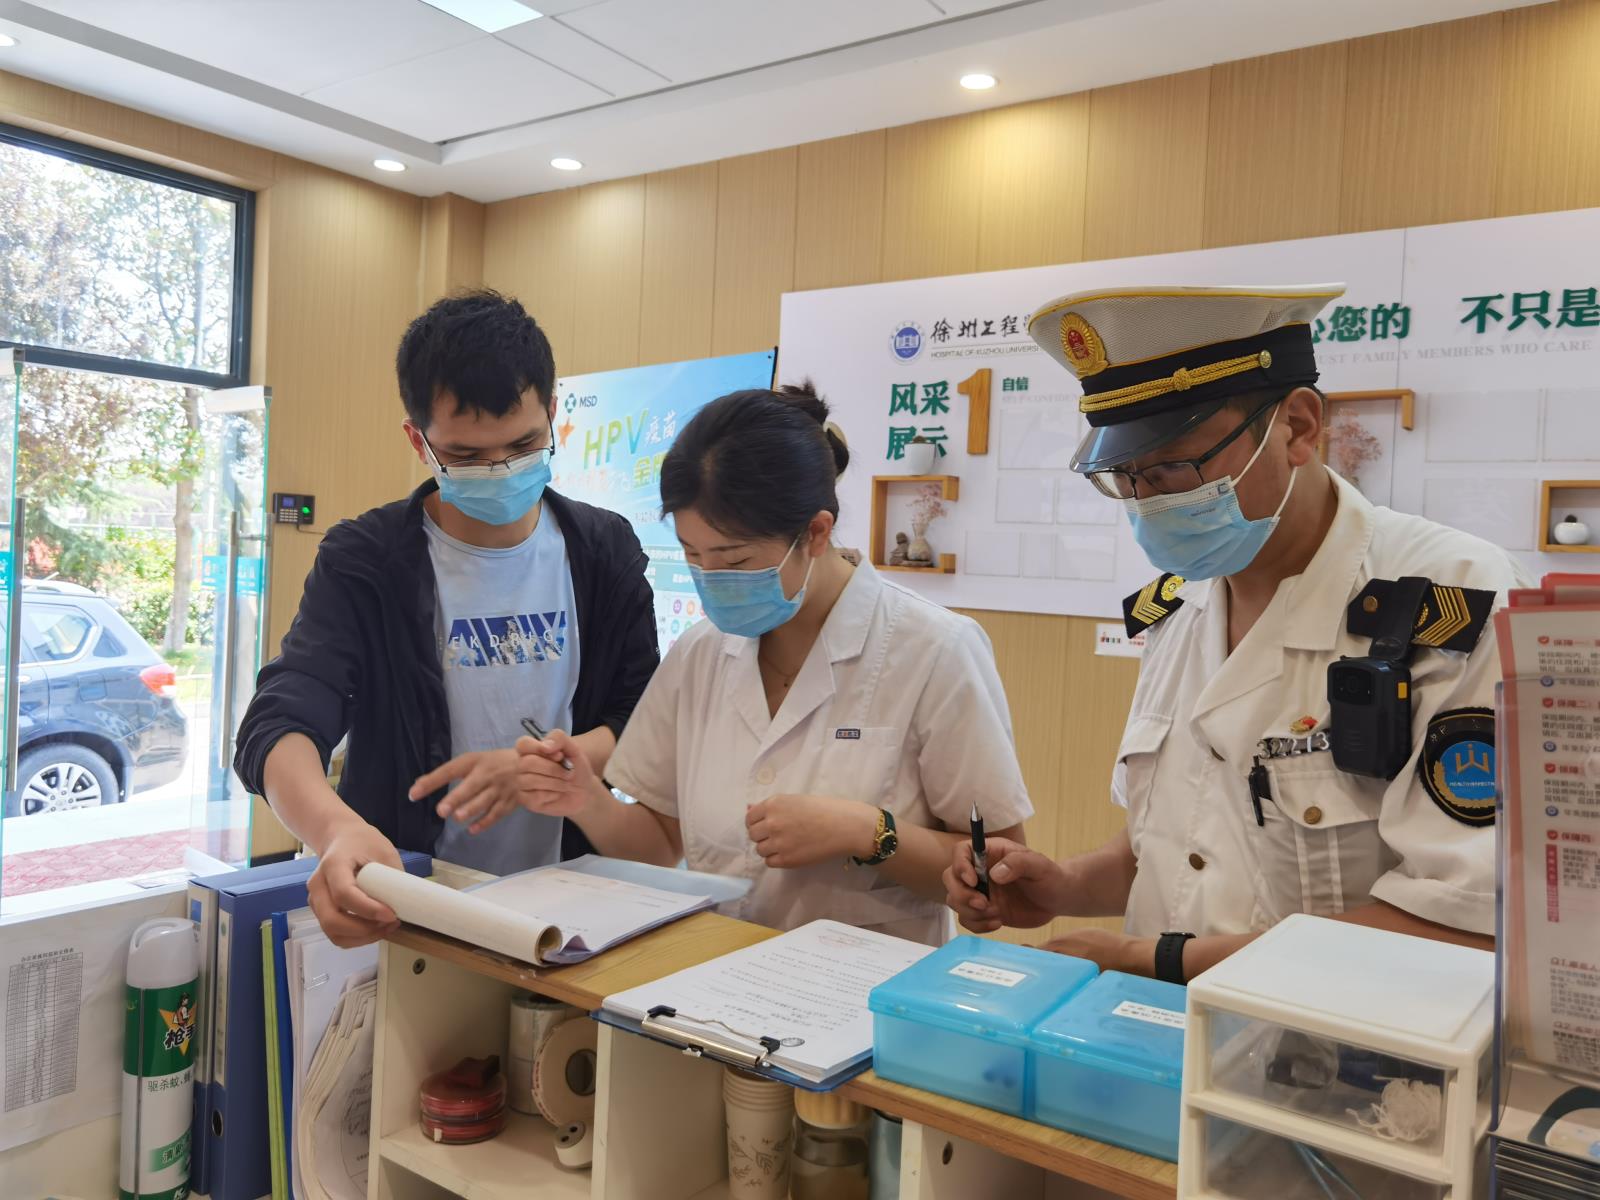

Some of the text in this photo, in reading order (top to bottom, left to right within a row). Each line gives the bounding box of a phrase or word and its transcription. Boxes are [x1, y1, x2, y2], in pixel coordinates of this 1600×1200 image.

[1460, 287, 1600, 334] 不只是
[930, 314, 1032, 343] 徐州工程
[1500, 342, 1539, 355] WHO
[1544, 340, 1592, 353] CARE
[889, 380, 950, 416] 风采
[1002, 377, 1029, 392] 自信
[579, 395, 598, 408] MSD
[163, 1023, 196, 1050] 枪手
